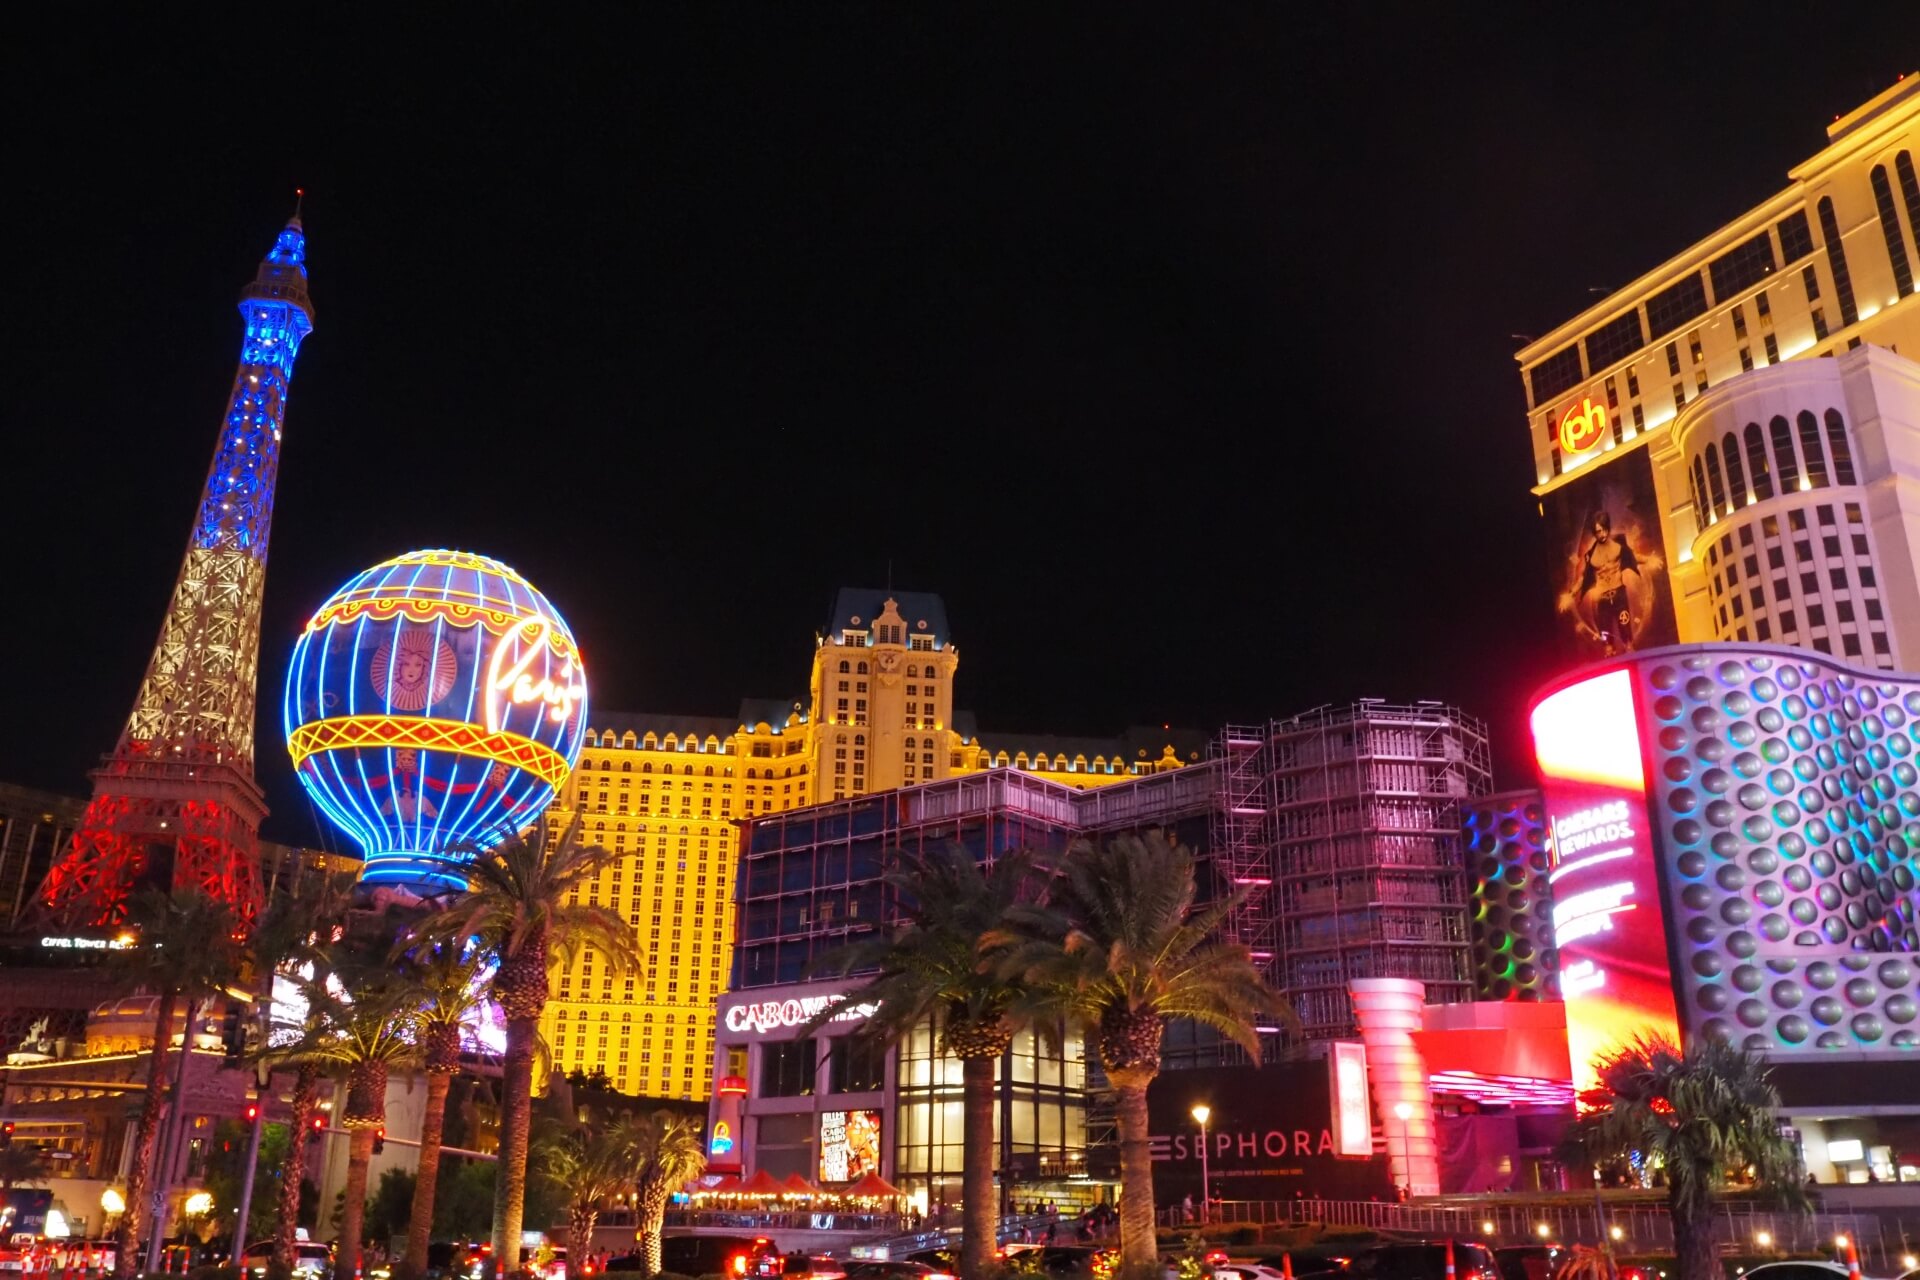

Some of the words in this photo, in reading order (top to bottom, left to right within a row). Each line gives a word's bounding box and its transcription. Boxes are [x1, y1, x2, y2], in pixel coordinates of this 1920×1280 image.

[1566, 398, 1605, 452] ph
[486, 614, 585, 735] Paris
[74, 938, 106, 949] TOWER
[725, 999, 802, 1034] CABO
[1174, 1130, 1335, 1160] SEPHORA
